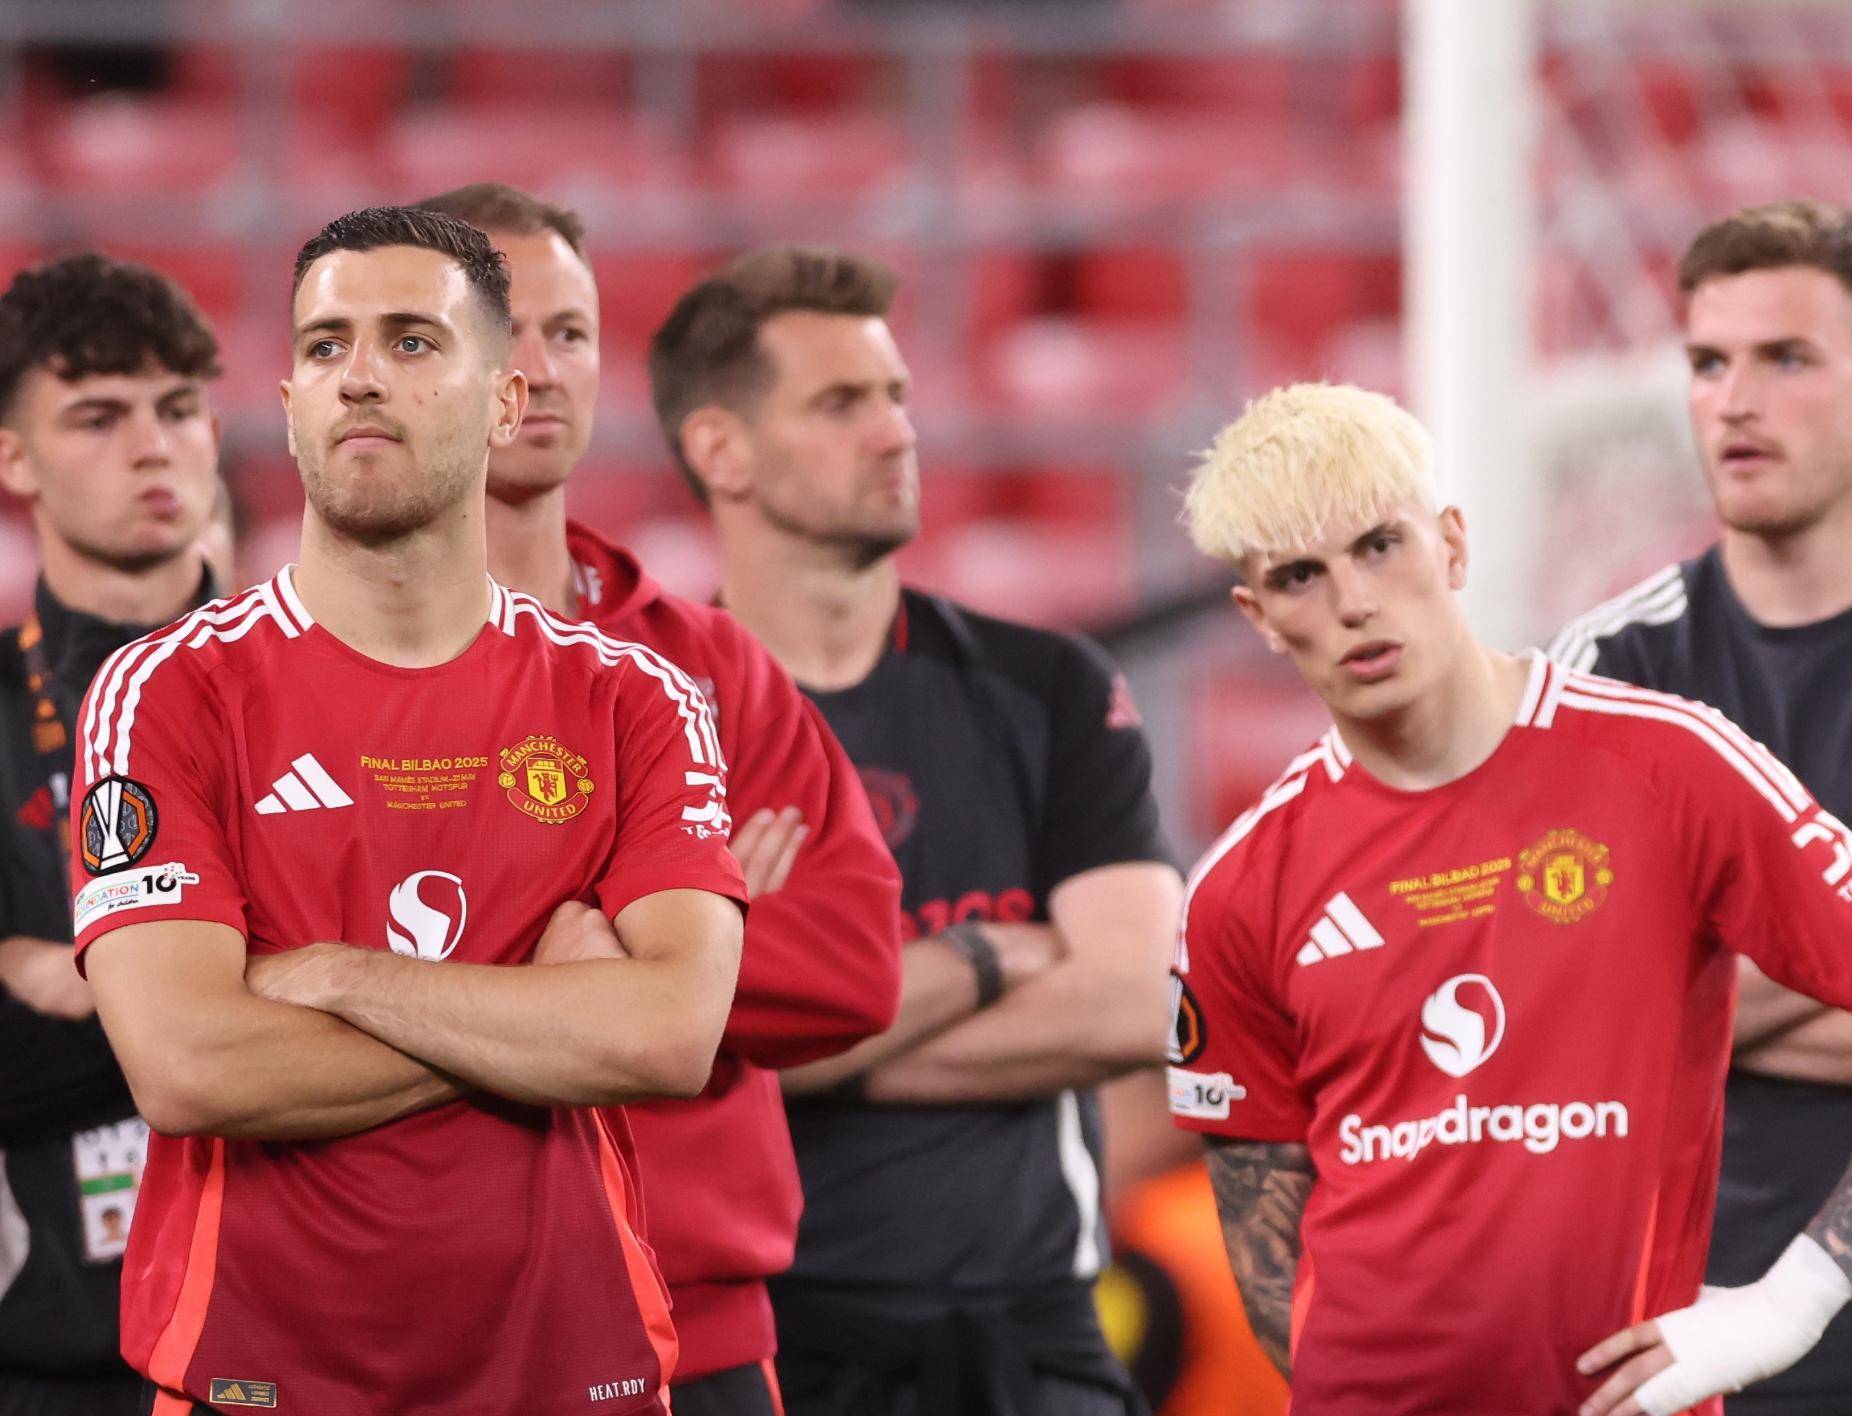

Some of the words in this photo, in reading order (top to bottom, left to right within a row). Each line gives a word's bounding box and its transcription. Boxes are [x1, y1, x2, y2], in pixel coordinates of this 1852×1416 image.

[360, 755, 400, 771] FINAL
[401, 758, 452, 771] BILBAO
[454, 756, 489, 769] 2025
[506, 741, 582, 772] MANCHESTER
[523, 800, 577, 818] UNITED
[141, 874, 177, 895] 10
[1338, 1092, 1630, 1166] Snapdragon
[588, 1377, 646, 1402] HEAT.RDY
